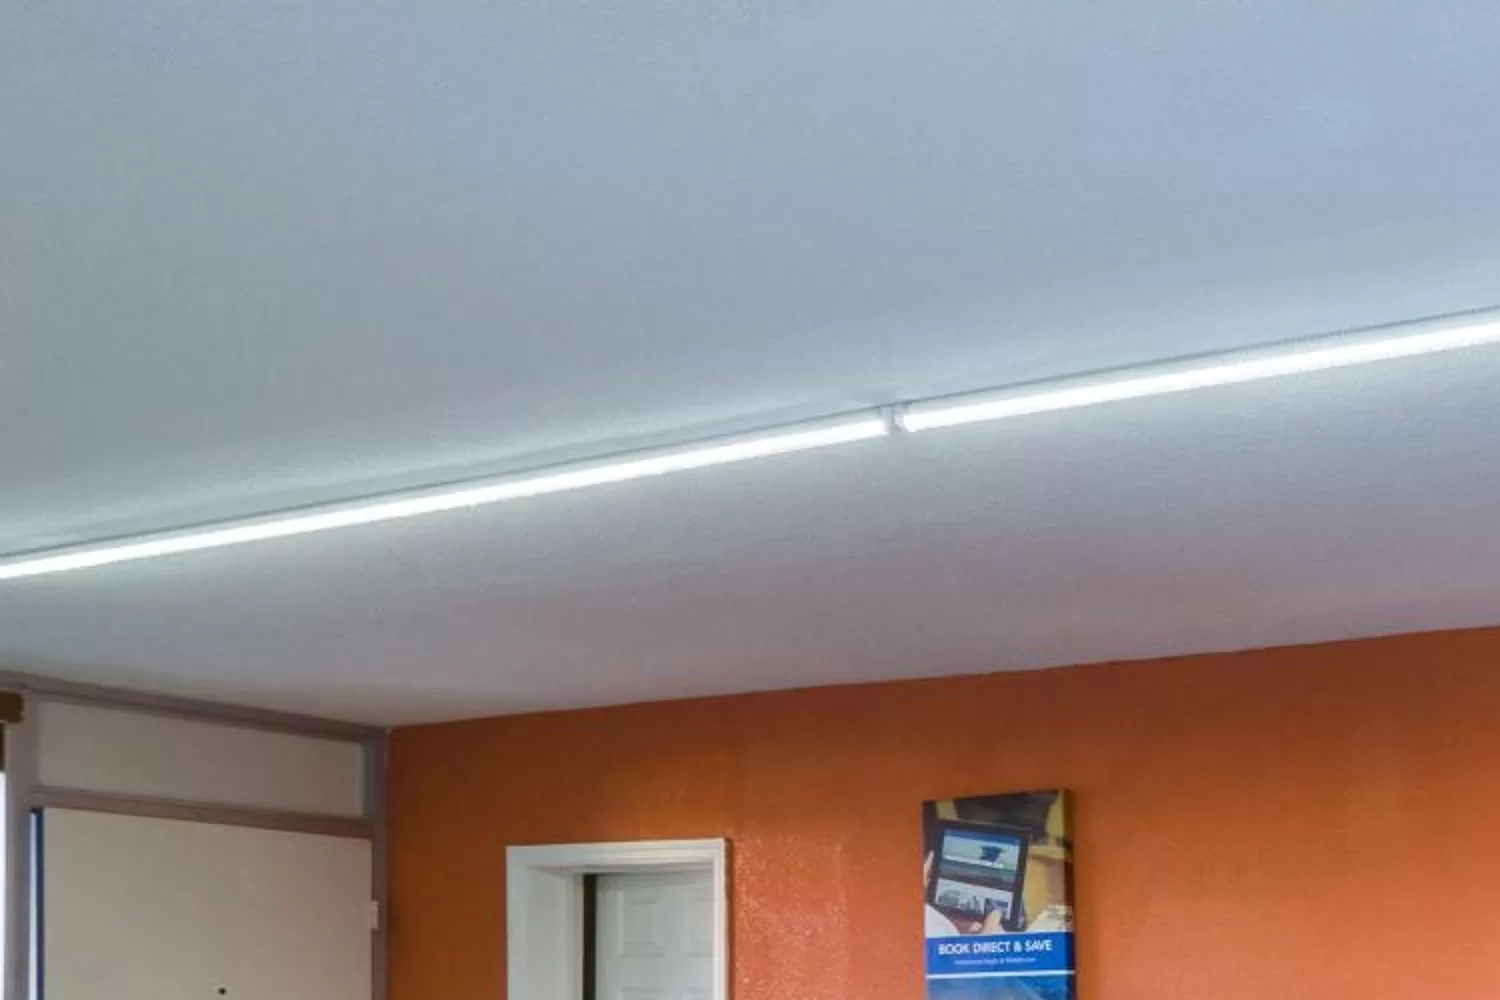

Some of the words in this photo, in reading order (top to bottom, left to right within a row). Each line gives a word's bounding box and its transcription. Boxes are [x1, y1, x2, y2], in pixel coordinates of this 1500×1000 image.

[938, 943, 970, 955] BOOK
[973, 941, 1011, 953] DIRECT
[1014, 940, 1023, 952] &
[1024, 939, 1053, 952] SAVE
